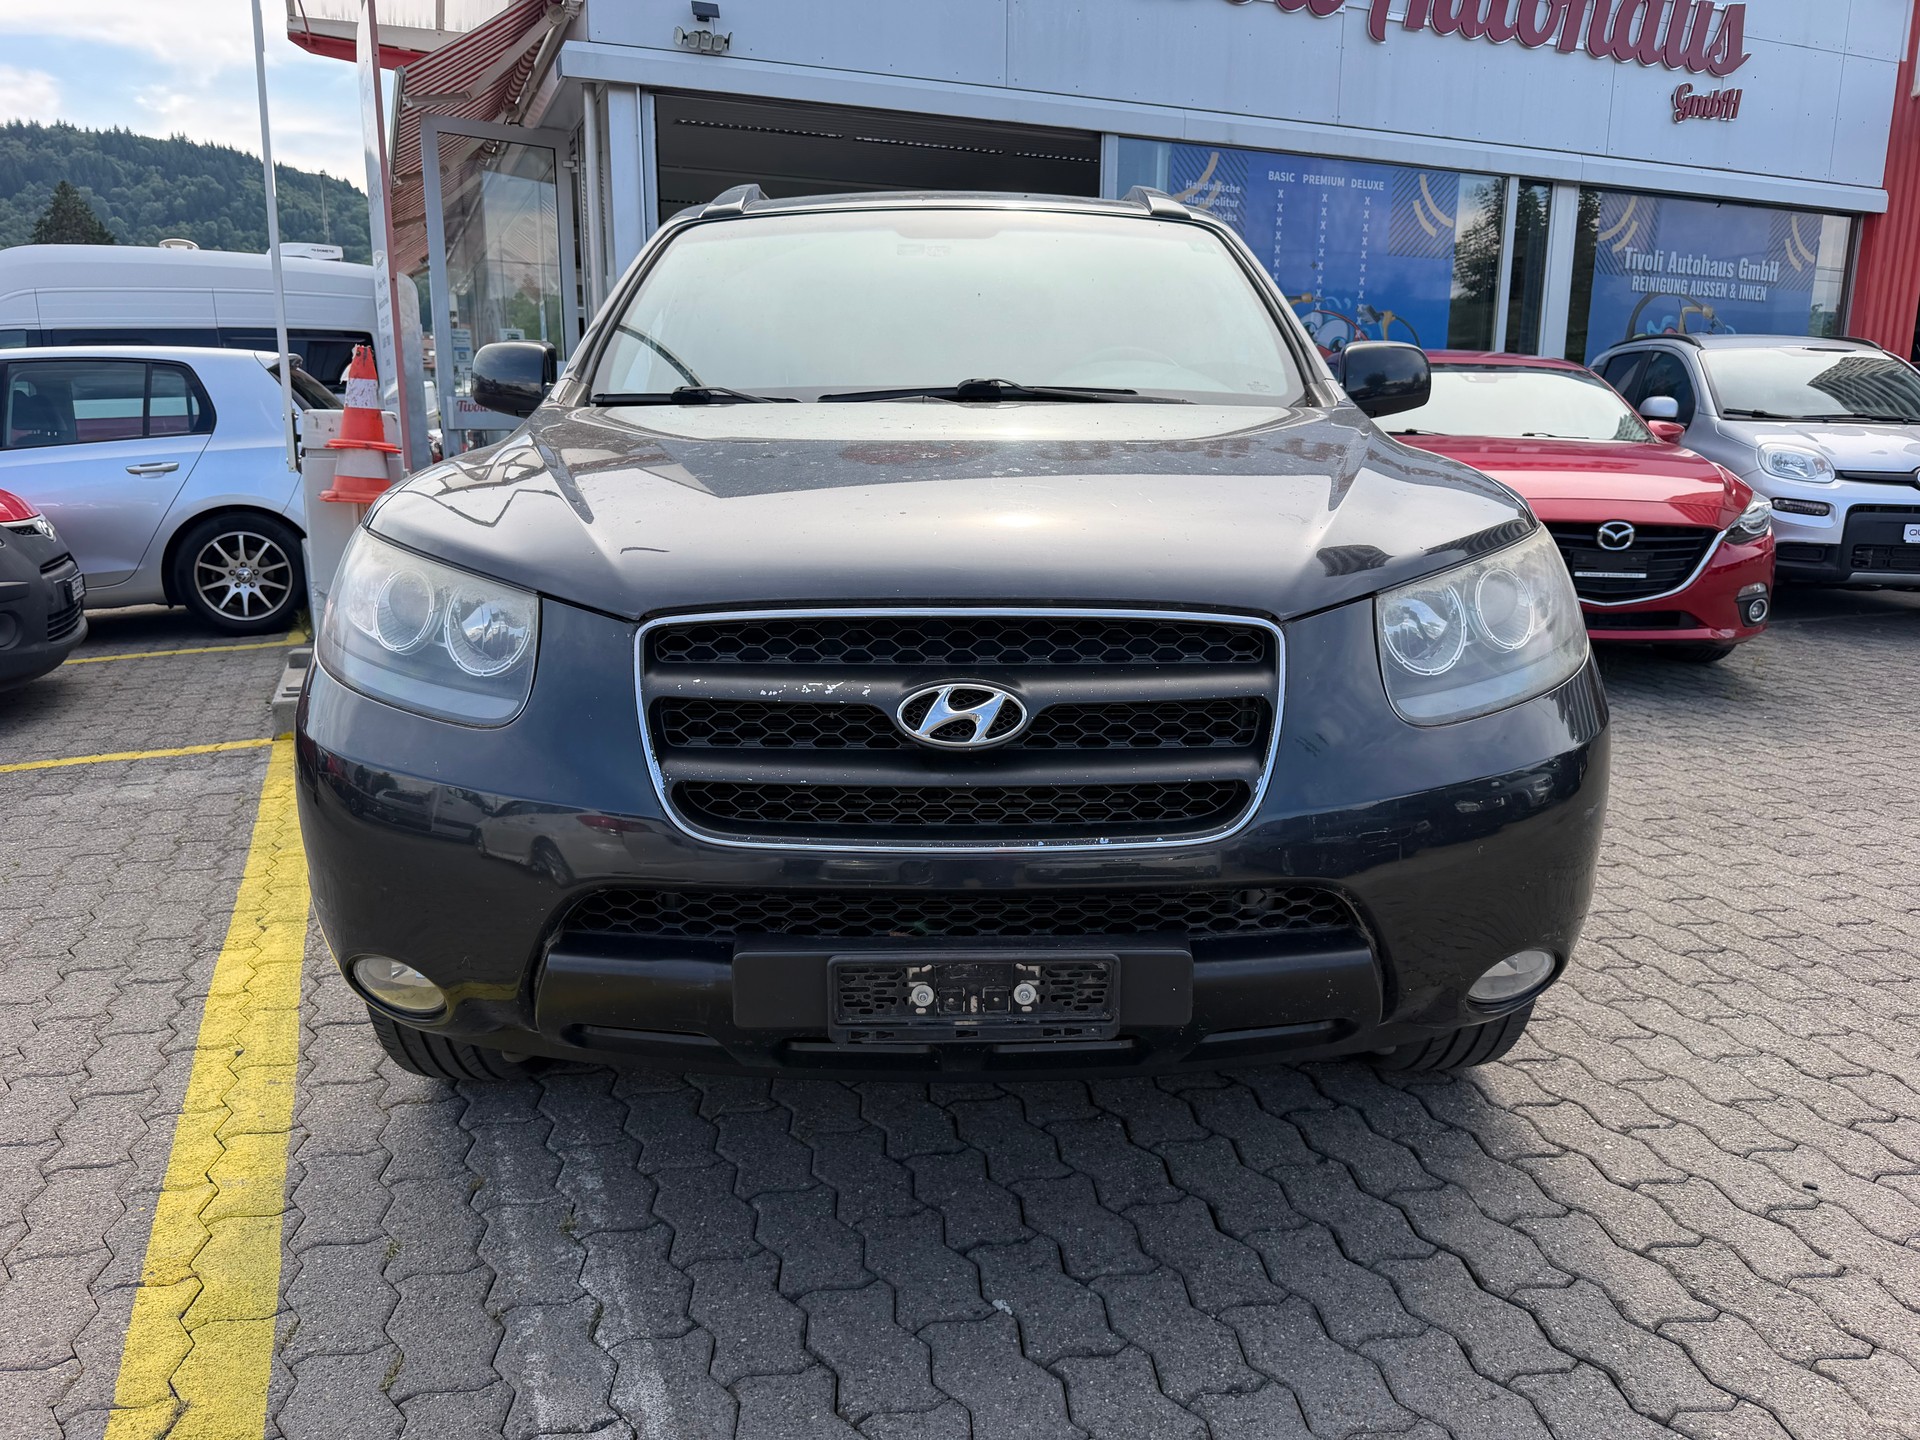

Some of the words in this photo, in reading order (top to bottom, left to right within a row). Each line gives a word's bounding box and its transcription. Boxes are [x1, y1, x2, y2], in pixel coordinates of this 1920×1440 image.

[1671, 82, 1743, 124] GmbH
[1268, 170, 1295, 182] BASIC
[1302, 174, 1345, 187] PREMIUM
[1351, 178, 1384, 191] DELUXE
[1624, 247, 1664, 272] Tivoli
[1667, 251, 1734, 278] Autohaus
[1738, 258, 1780, 282] GmbH
[1632, 276, 1688, 295] REINIGUNG
[1689, 281, 1727, 298] AUSSEN
[1730, 284, 1736, 298] &
[1738, 284, 1768, 300] INNEN
